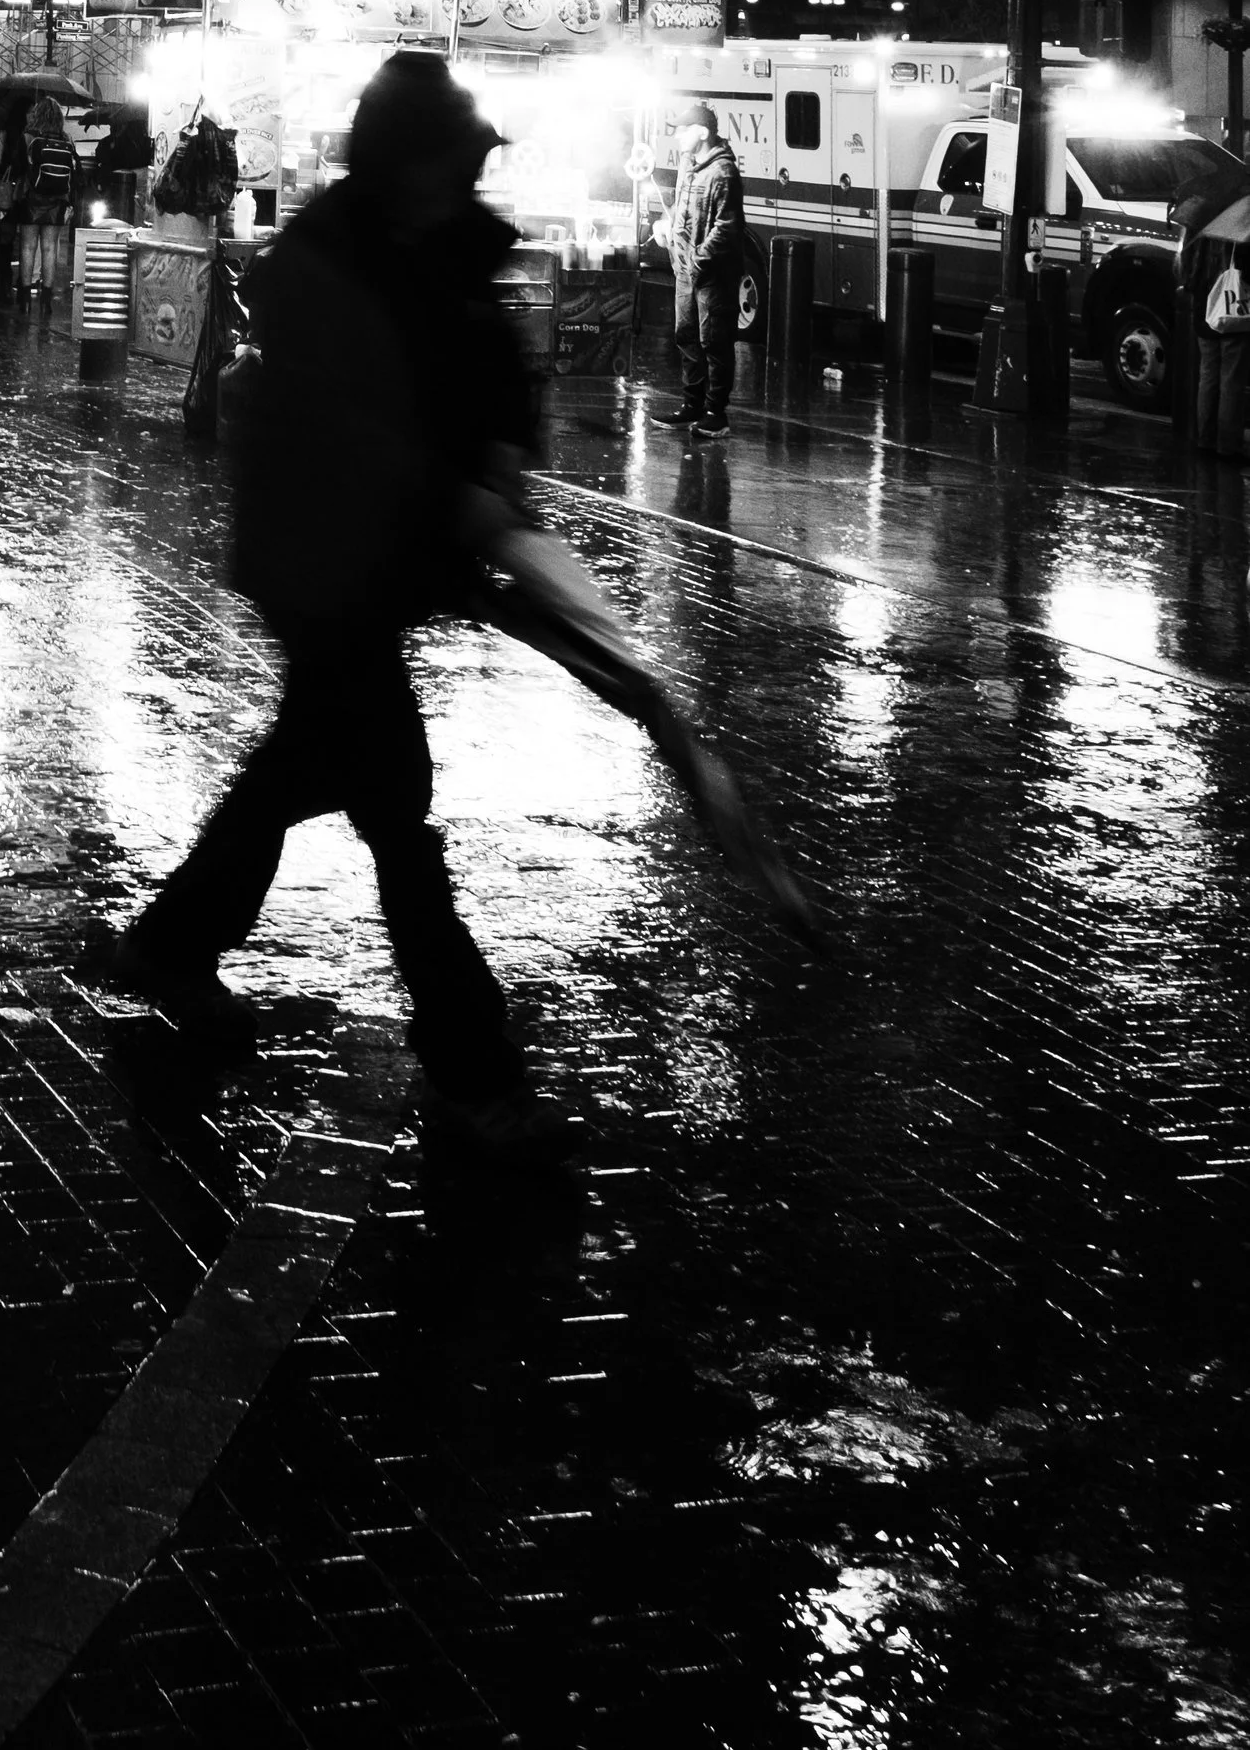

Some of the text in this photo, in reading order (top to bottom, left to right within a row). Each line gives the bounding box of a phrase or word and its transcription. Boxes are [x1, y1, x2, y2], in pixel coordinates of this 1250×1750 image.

[728, 112, 768, 144] N.Y.
[558, 323, 600, 334] Corn Dog
[558, 344, 574, 352] NY
